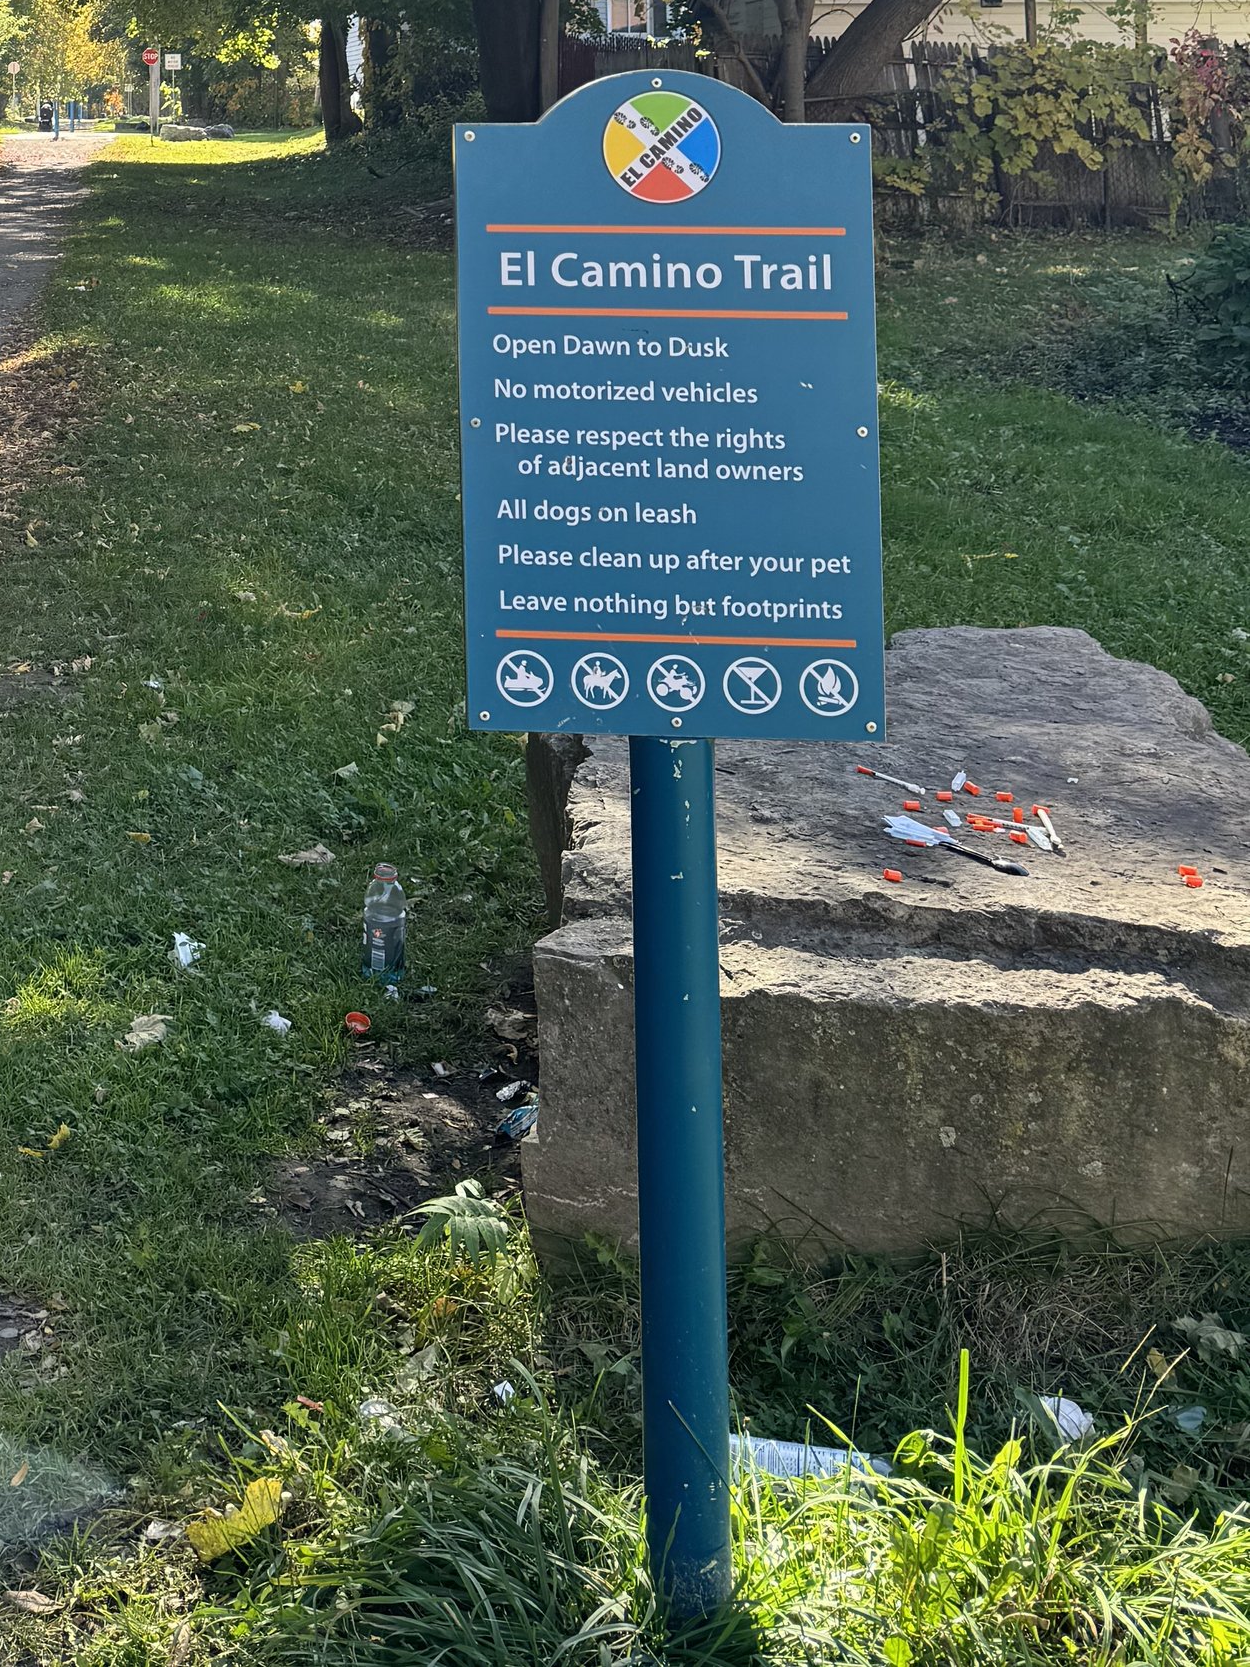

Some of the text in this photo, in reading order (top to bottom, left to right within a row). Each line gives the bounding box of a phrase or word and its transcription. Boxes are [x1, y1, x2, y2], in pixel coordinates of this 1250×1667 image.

[620, 106, 703, 188] EL CAMINO
[501, 251, 832, 290] El Camino Trail
[493, 334, 729, 358] Open Dawn to Dusk
[495, 379, 758, 404] No motorized vehicles
[496, 423, 786, 454] Please respect the rights
[519, 455, 804, 482] of adjacent land owners
[498, 499, 697, 526] All dogs on leash
[499, 544, 851, 578] Please clean up after your pet
[501, 590, 843, 623] Leave nothing but footprints
